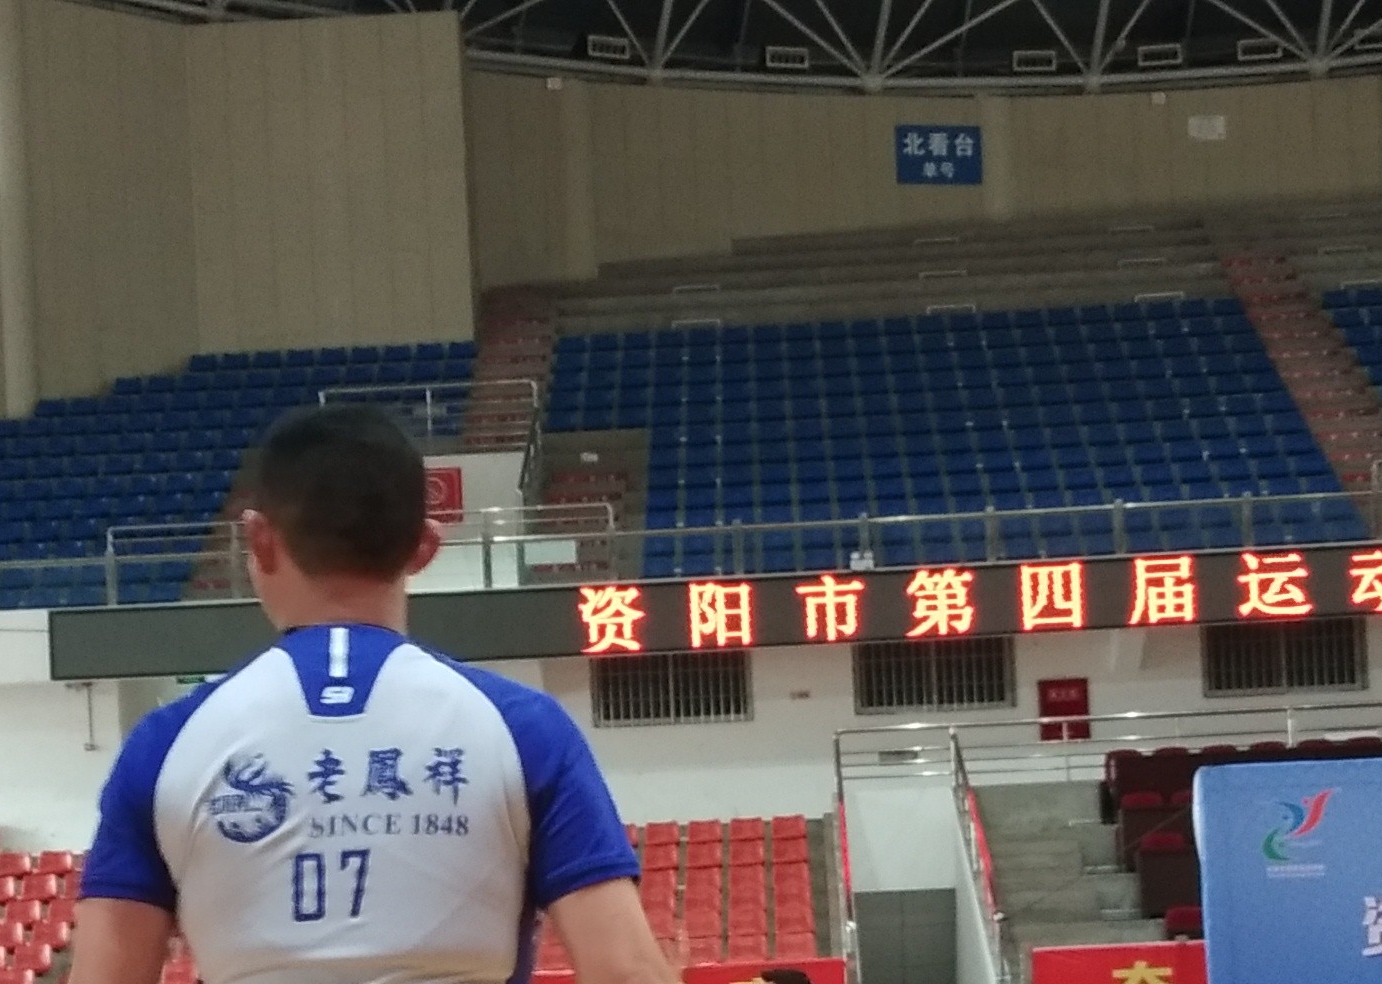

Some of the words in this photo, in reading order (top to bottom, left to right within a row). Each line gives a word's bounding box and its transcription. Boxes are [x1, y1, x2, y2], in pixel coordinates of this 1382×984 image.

[902, 131, 974, 157] 北看台
[307, 748, 469, 806] 老鳳祥
[309, 814, 402, 838] SINCE
[412, 813, 469, 837] 1848
[292, 848, 370, 922] 07
